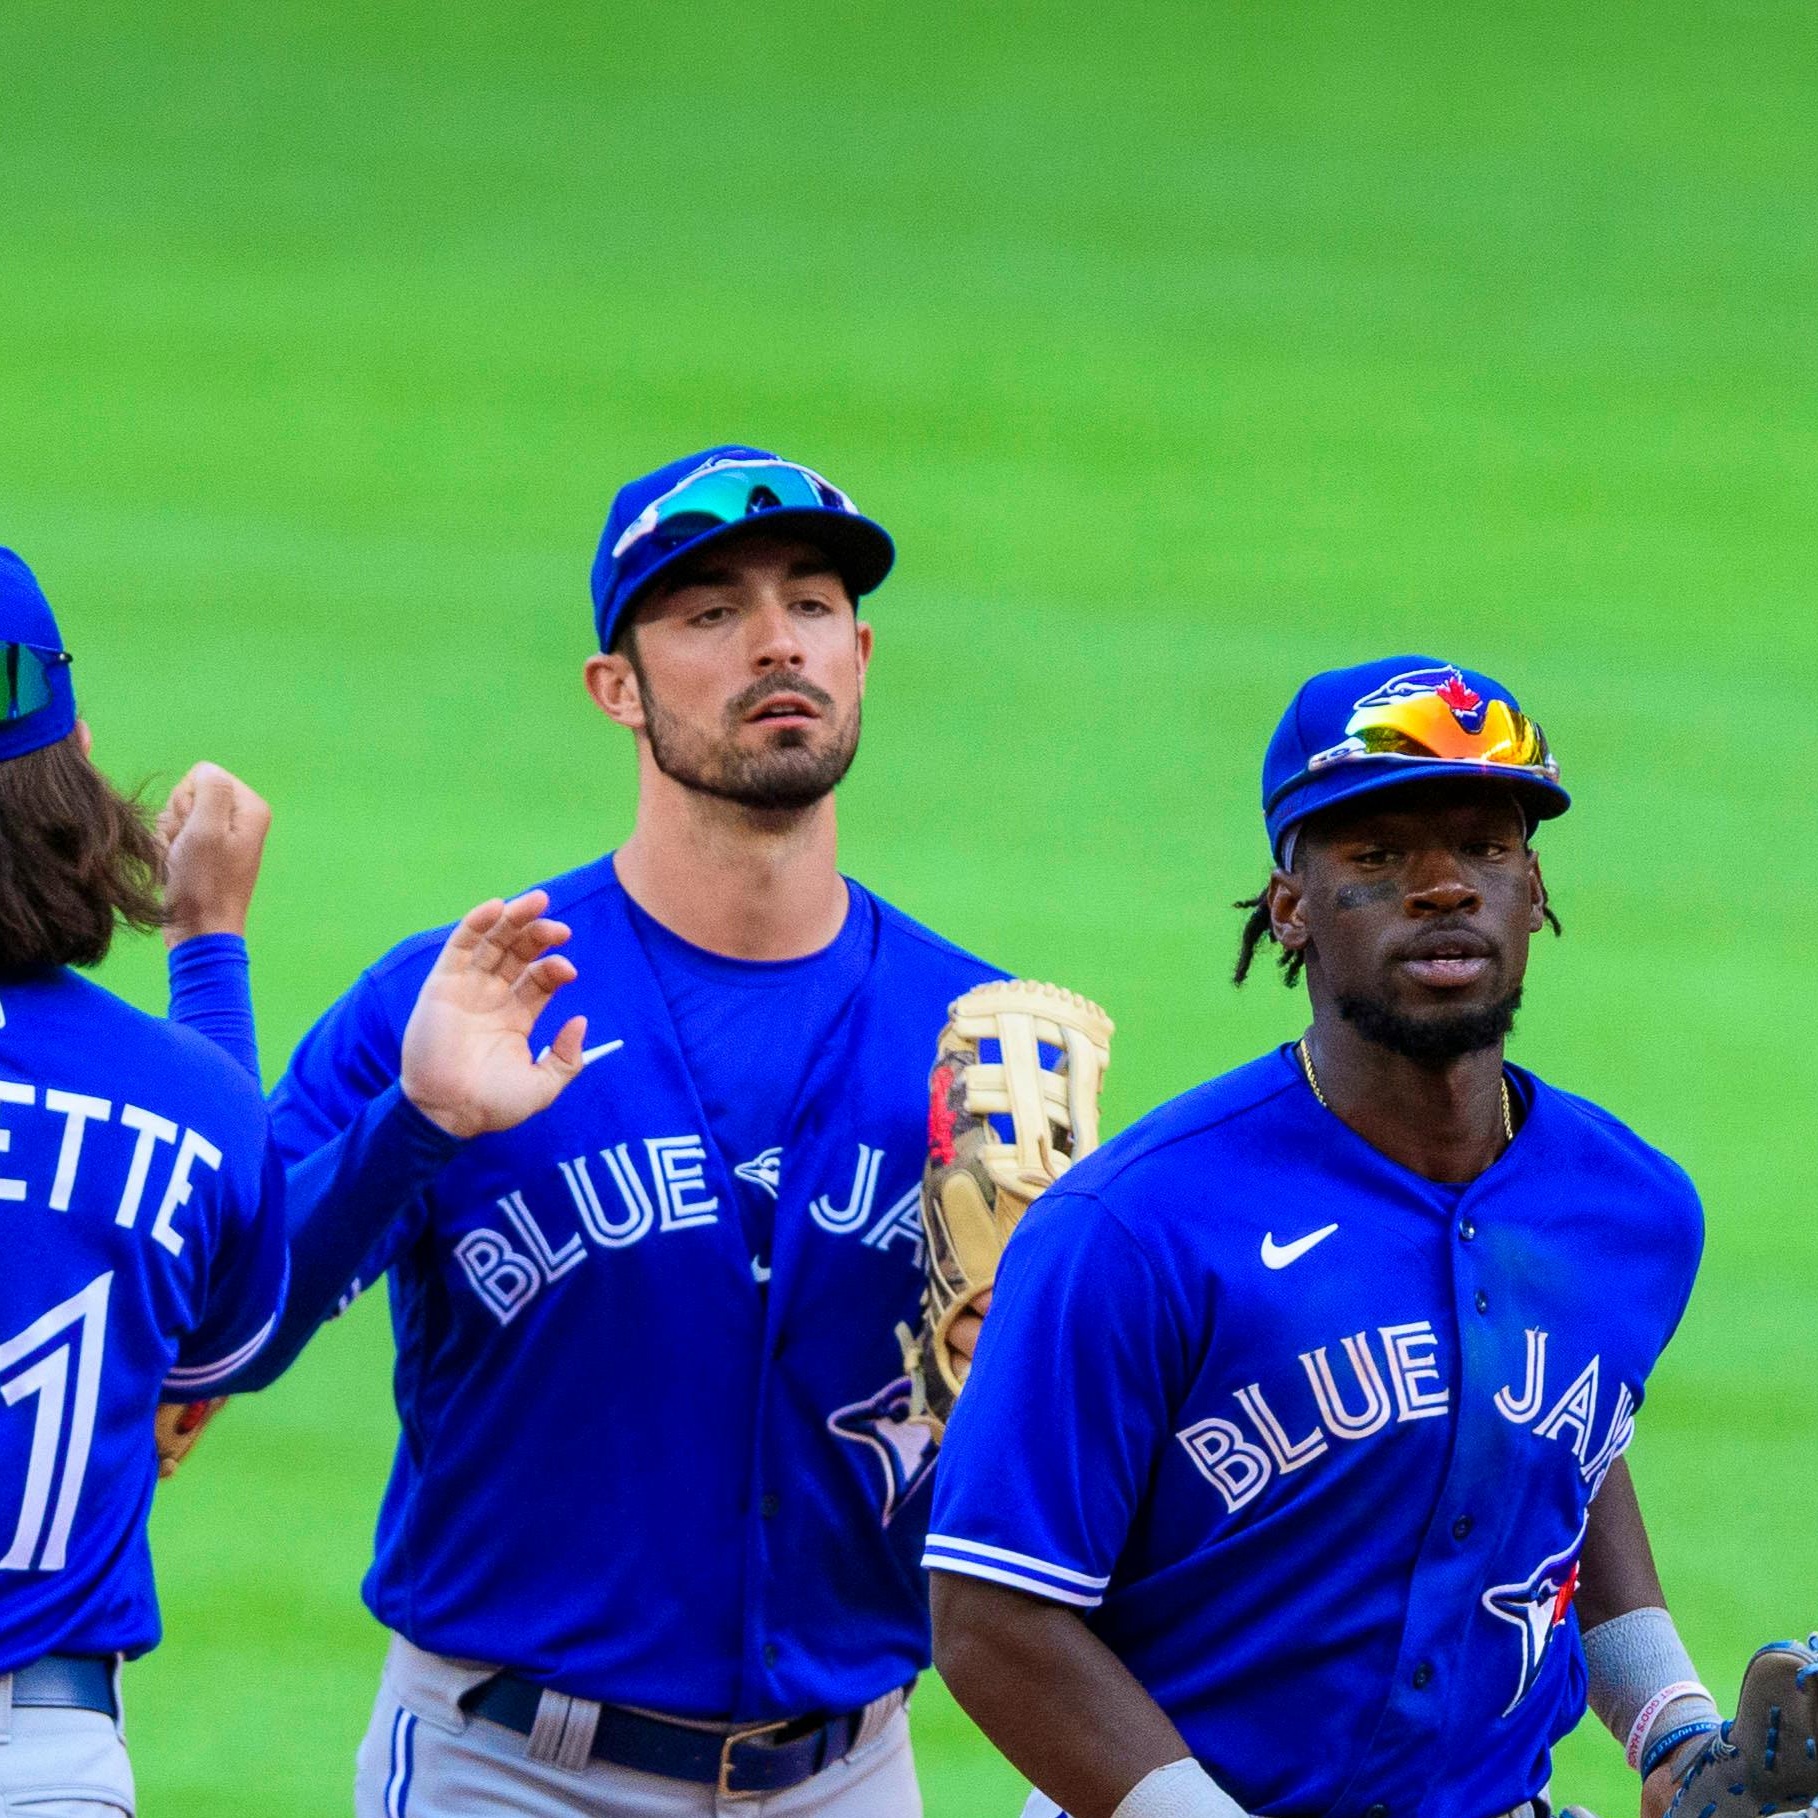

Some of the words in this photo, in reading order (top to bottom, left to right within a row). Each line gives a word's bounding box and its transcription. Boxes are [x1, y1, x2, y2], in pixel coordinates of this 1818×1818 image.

[457, 1135, 718, 1325] BLUE
[809, 1143, 931, 1278] JA
[1176, 1321, 1449, 1514] BLUE
